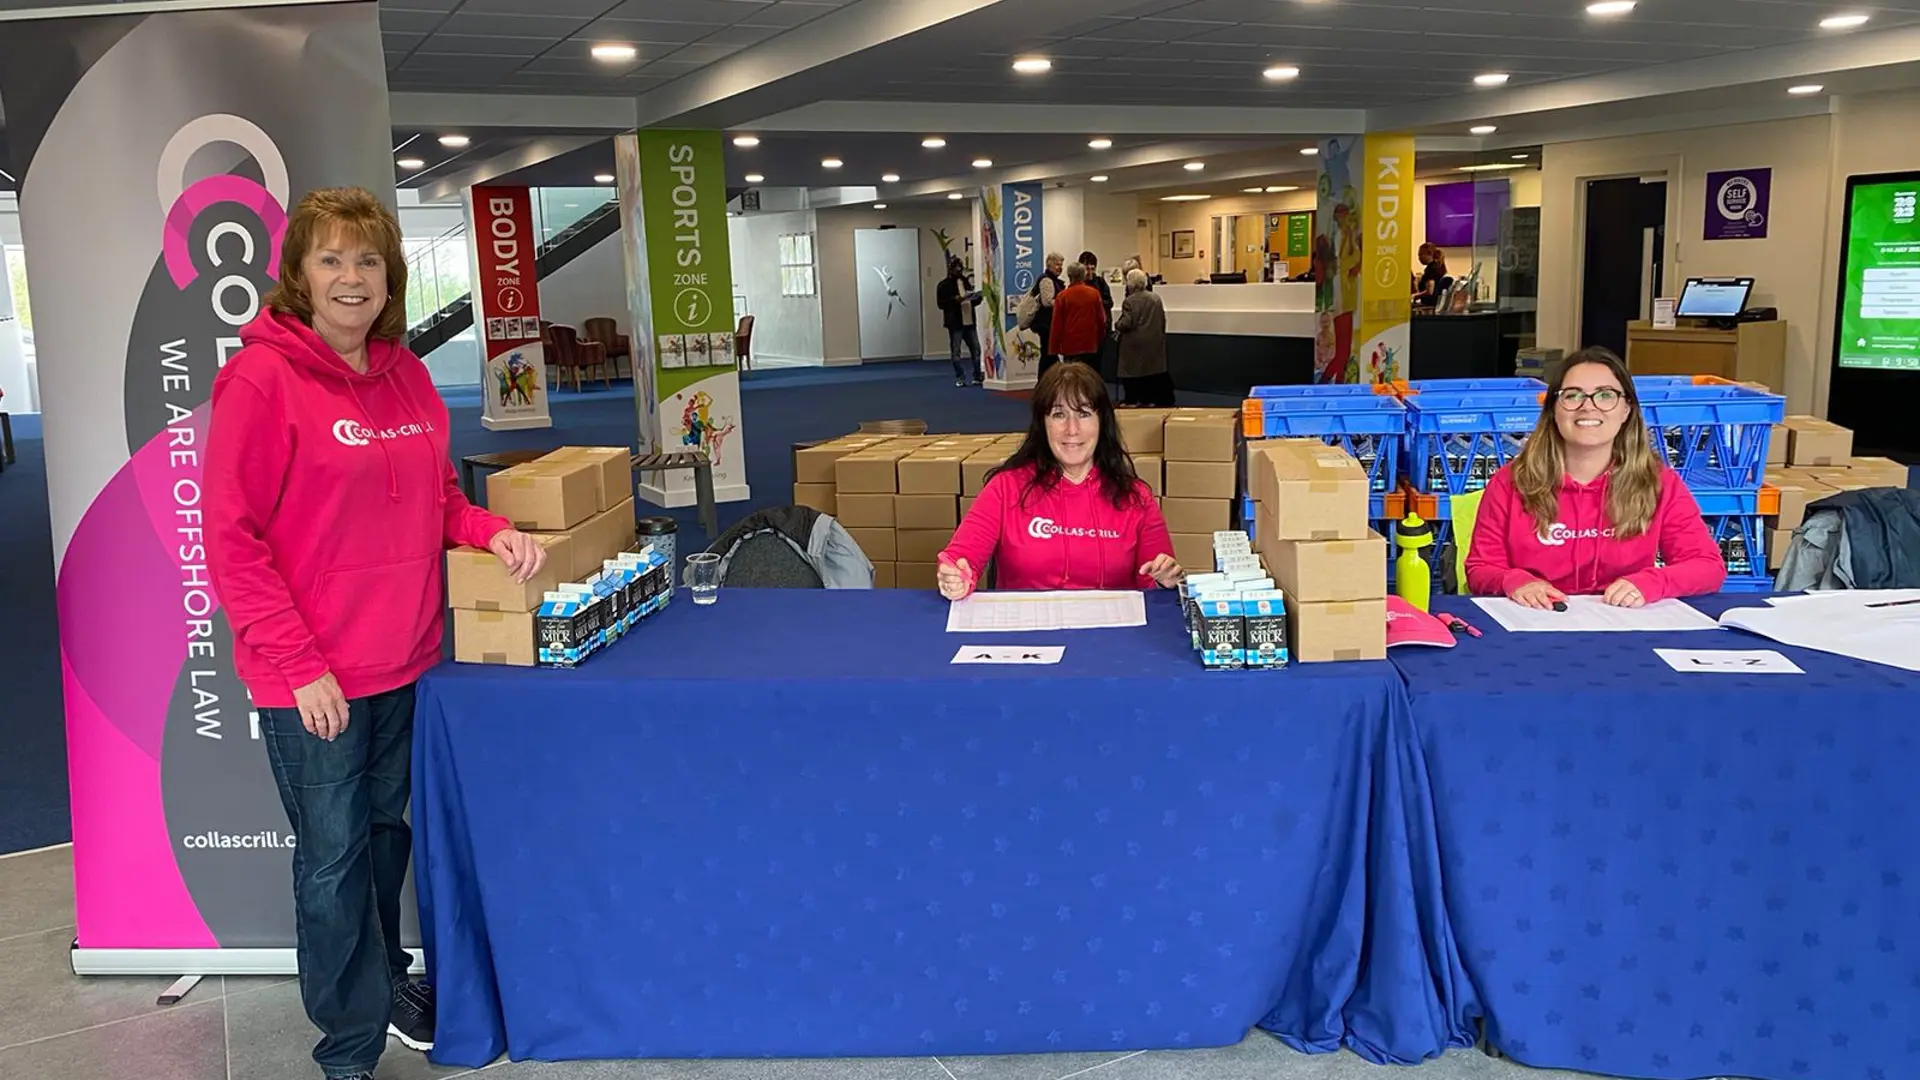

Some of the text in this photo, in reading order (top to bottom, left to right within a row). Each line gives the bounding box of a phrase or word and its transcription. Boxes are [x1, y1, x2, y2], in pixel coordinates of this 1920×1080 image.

[1377, 157, 1399, 240] KIDS
[1726, 187, 1747, 199] SELF
[669, 143, 702, 267] SPORTS
[1014, 190, 1032, 260] AQUA
[489, 197, 521, 276] BODY
[1015, 261, 1033, 269] ZONE
[497, 276, 521, 286] ZONE
[674, 273, 708, 286] ZONE
[160, 338, 223, 740] WE ARE OFFSHORE LAW
[541, 630, 571, 643] MILK
[1208, 629, 1240, 643] MILK
[1250, 628, 1283, 643] MILK
[1741, 658, 1767, 666] Z
[183, 830, 297, 849] collascrill.c
